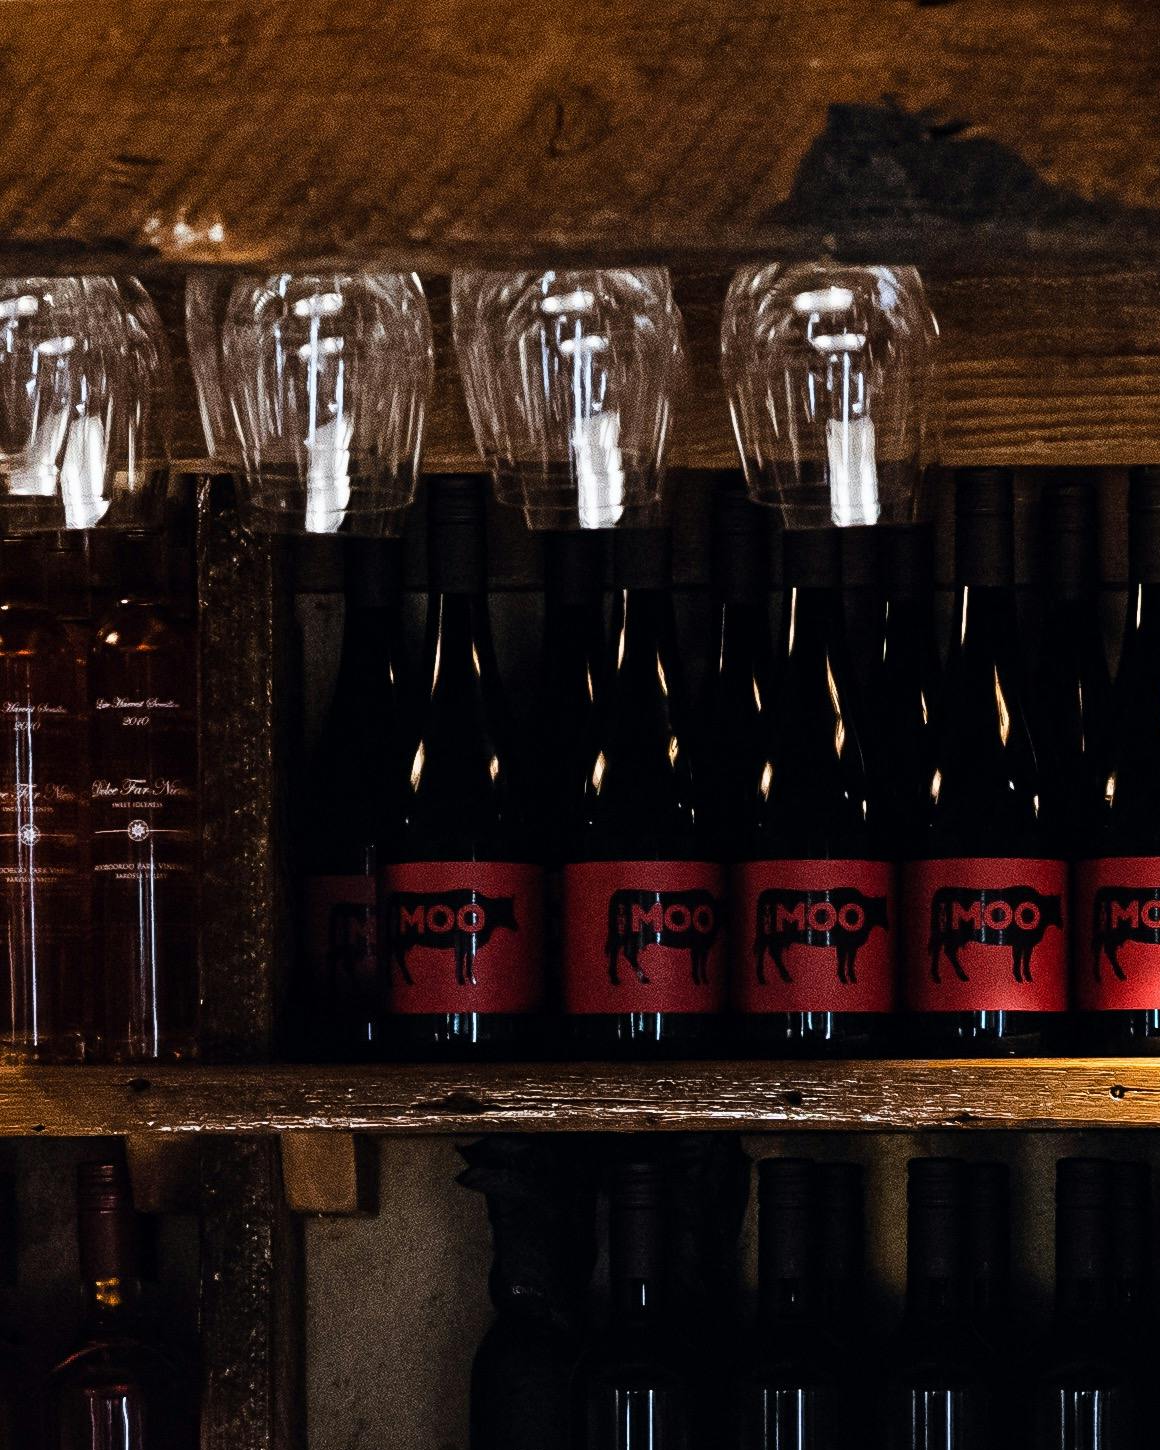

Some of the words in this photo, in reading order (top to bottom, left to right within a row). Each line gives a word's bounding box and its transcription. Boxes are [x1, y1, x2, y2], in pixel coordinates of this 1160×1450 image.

[119, 778, 148, 797] Far
[400, 904, 487, 936] MOO
[631, 903, 716, 934] MOO
[776, 902, 866, 933] MOO
[951, 900, 1041, 930] MOO
